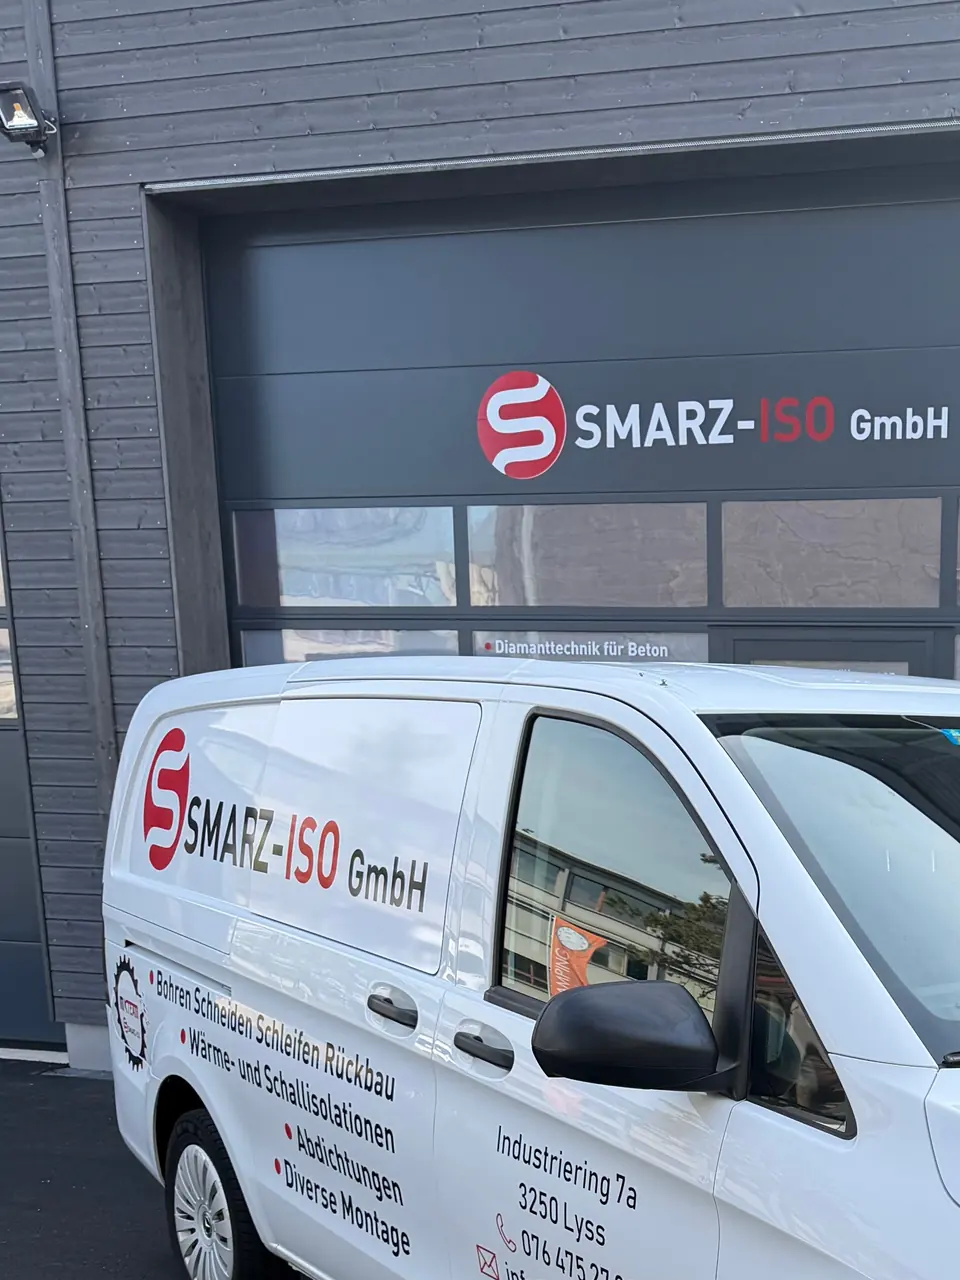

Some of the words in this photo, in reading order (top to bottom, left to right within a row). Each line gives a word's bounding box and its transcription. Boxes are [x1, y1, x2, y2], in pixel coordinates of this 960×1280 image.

[574, 396, 835, 449] SMARZ-ISO
[849, 406, 949, 441] GmbH
[495, 639, 600, 657] Diamanttechnik
[603, 641, 625, 657] für
[628, 641, 669, 658] Beton
[184, 795, 340, 889] SMARZ-ISO
[348, 848, 429, 912] GmbH
[157, 969, 191, 1012] Bohren
[194, 986, 252, 1040] Schneiden
[256, 1013, 320, 1069] Schleifen
[324, 1041, 396, 1101] Rückbau
[189, 1026, 235, 1072] Wärme-
[238, 1058, 262, 1089] und
[264, 1064, 396, 1154] Schallisolationen
[296, 1124, 404, 1206] Abdichtungen
[496, 1125, 611, 1205] Industriering
[616, 1173, 638, 1210] 7a
[284, 1158, 338, 1215] Diverse
[340, 1190, 411, 1257] Montage
[518, 1182, 559, 1225] 3250
[564, 1201, 606, 1246] Lyss
[521, 1229, 551, 1266] 076
